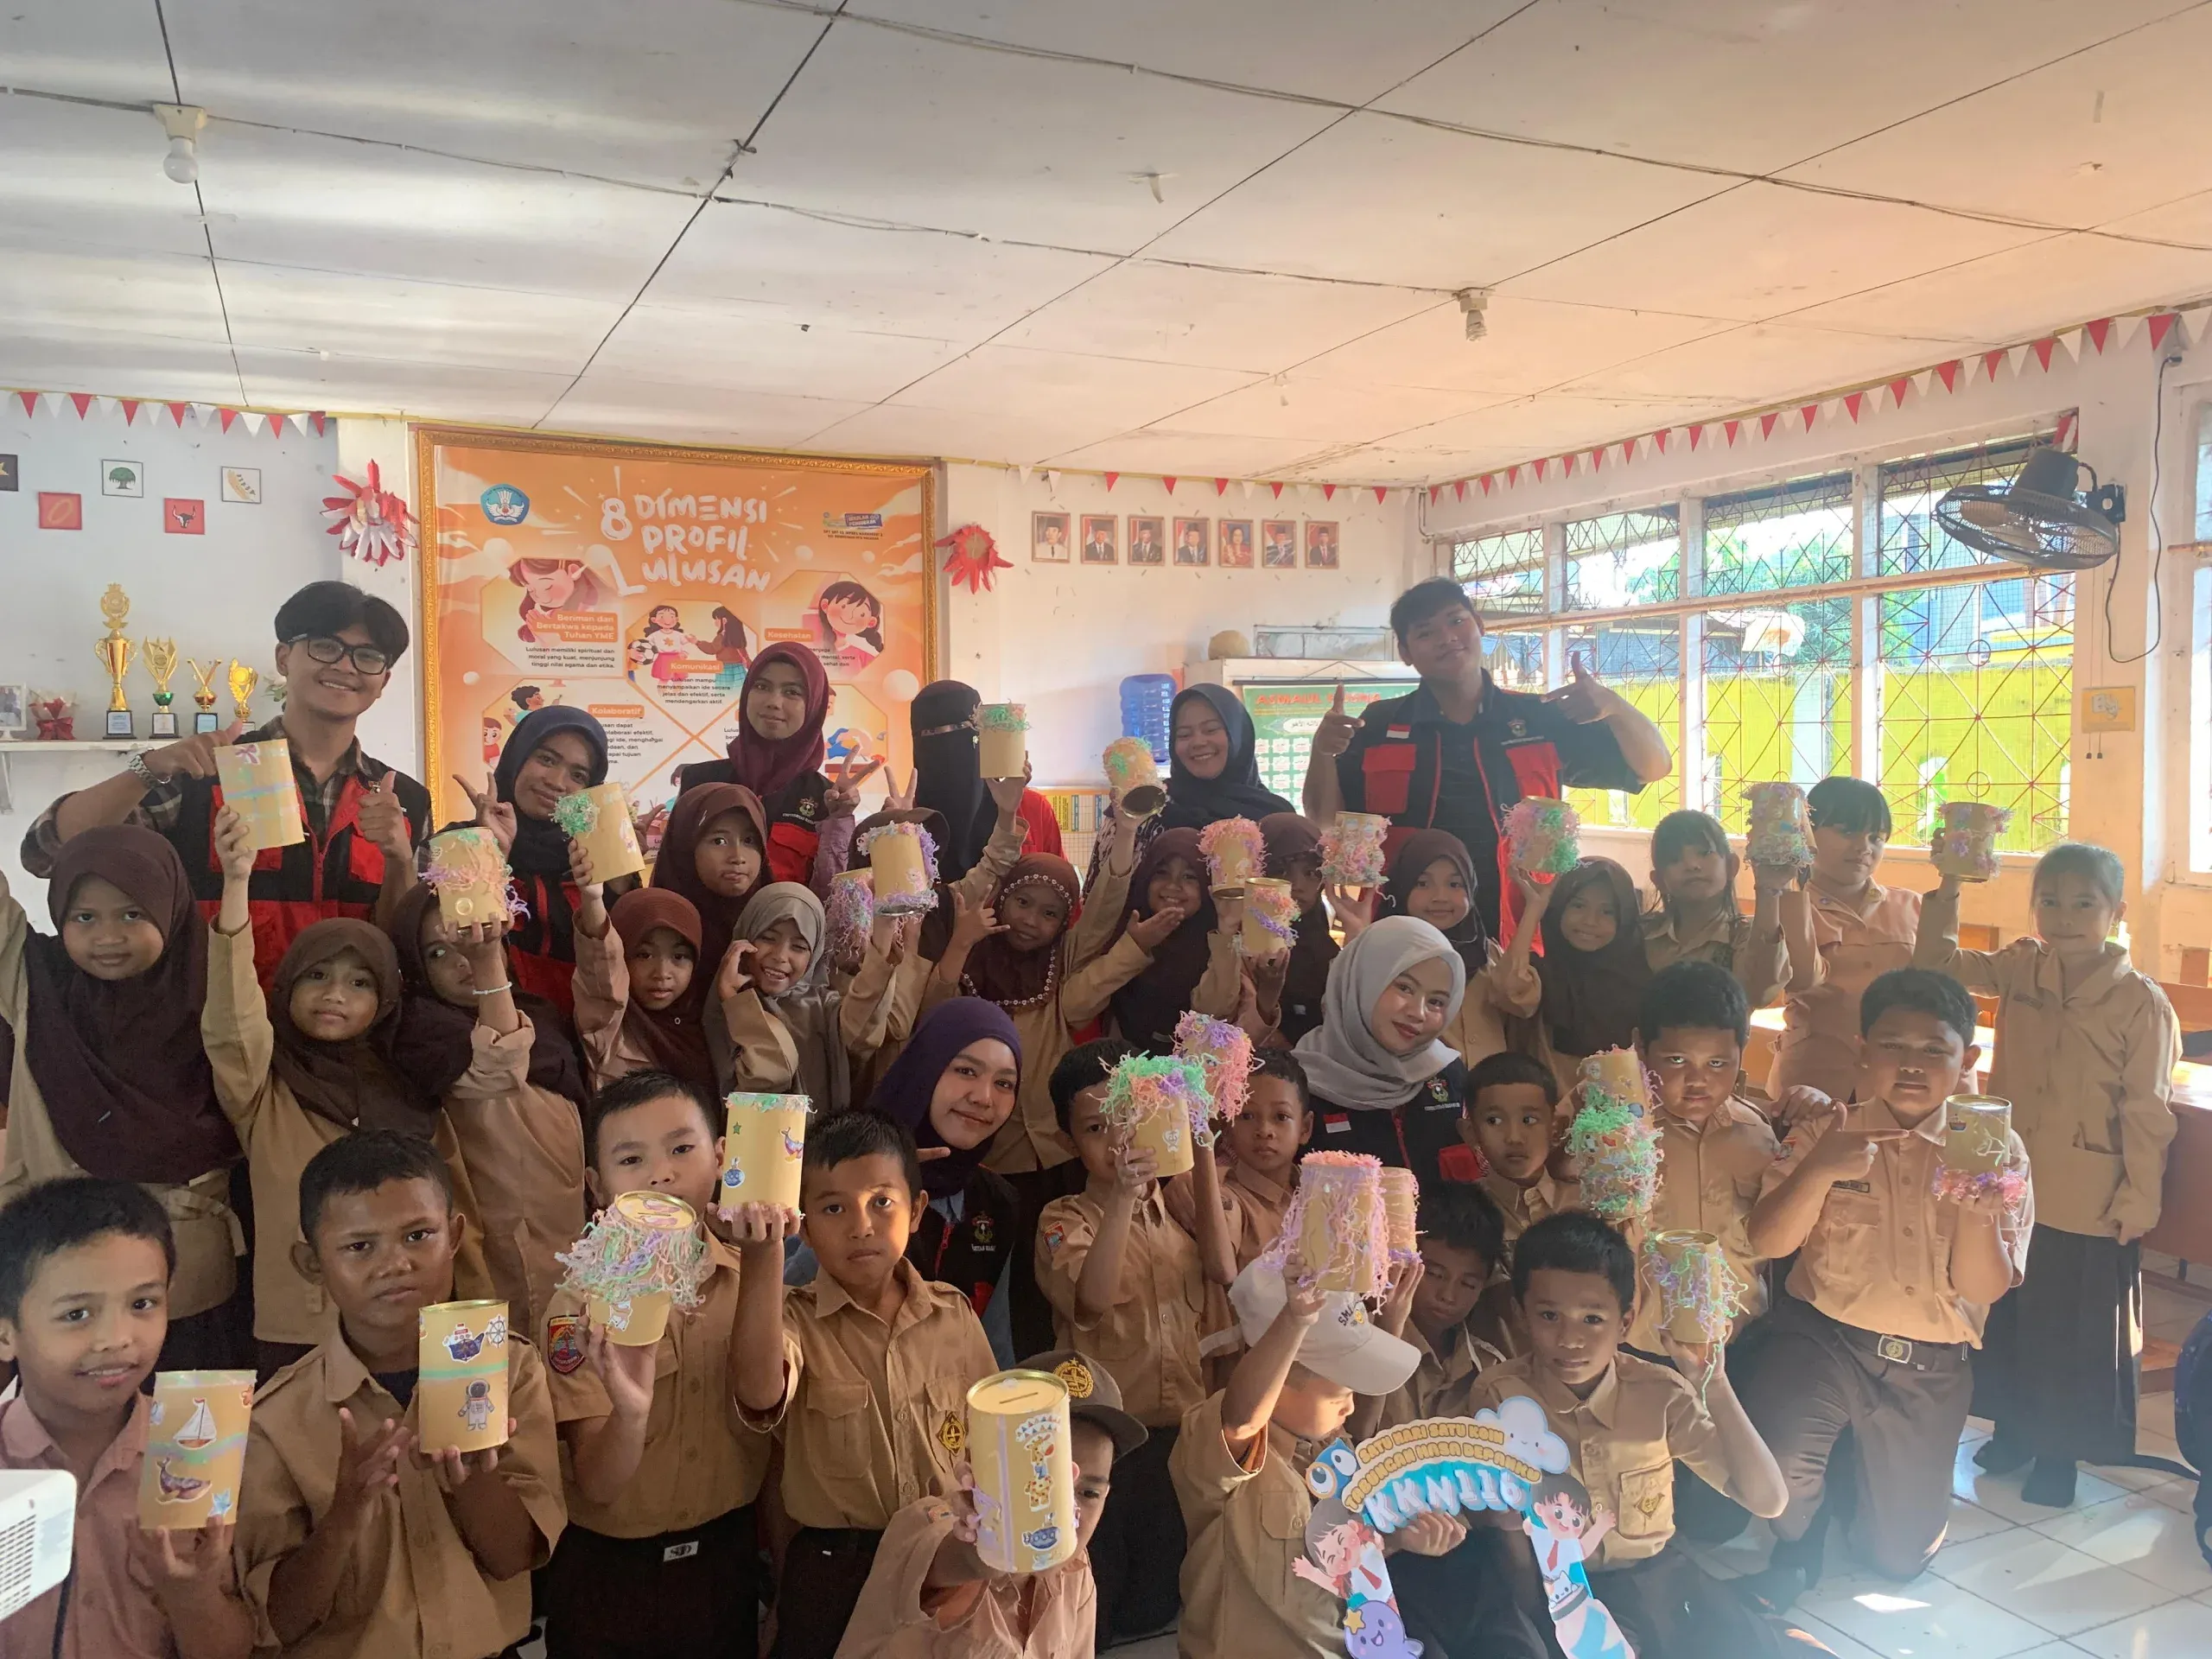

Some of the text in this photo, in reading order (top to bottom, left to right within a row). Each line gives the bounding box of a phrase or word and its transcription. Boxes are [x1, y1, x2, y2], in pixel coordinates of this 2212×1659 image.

[601, 487, 767, 541] 8 DIMENSI
[640, 524, 748, 561] PROFIL
[609, 553, 771, 597] LULUSAN
[557, 613, 595, 622] Beriman
[581, 623, 614, 632] kepada
[564, 631, 593, 639] Tuhan
[767, 631, 811, 639] Kesehatan
[1255, 694, 1323, 705] ASMAUL
[1358, 1422, 1505, 1465] SATU HARI SATU KOIN
[1344, 1441, 1542, 1510] TABUNGAN MASA DEPANKU
